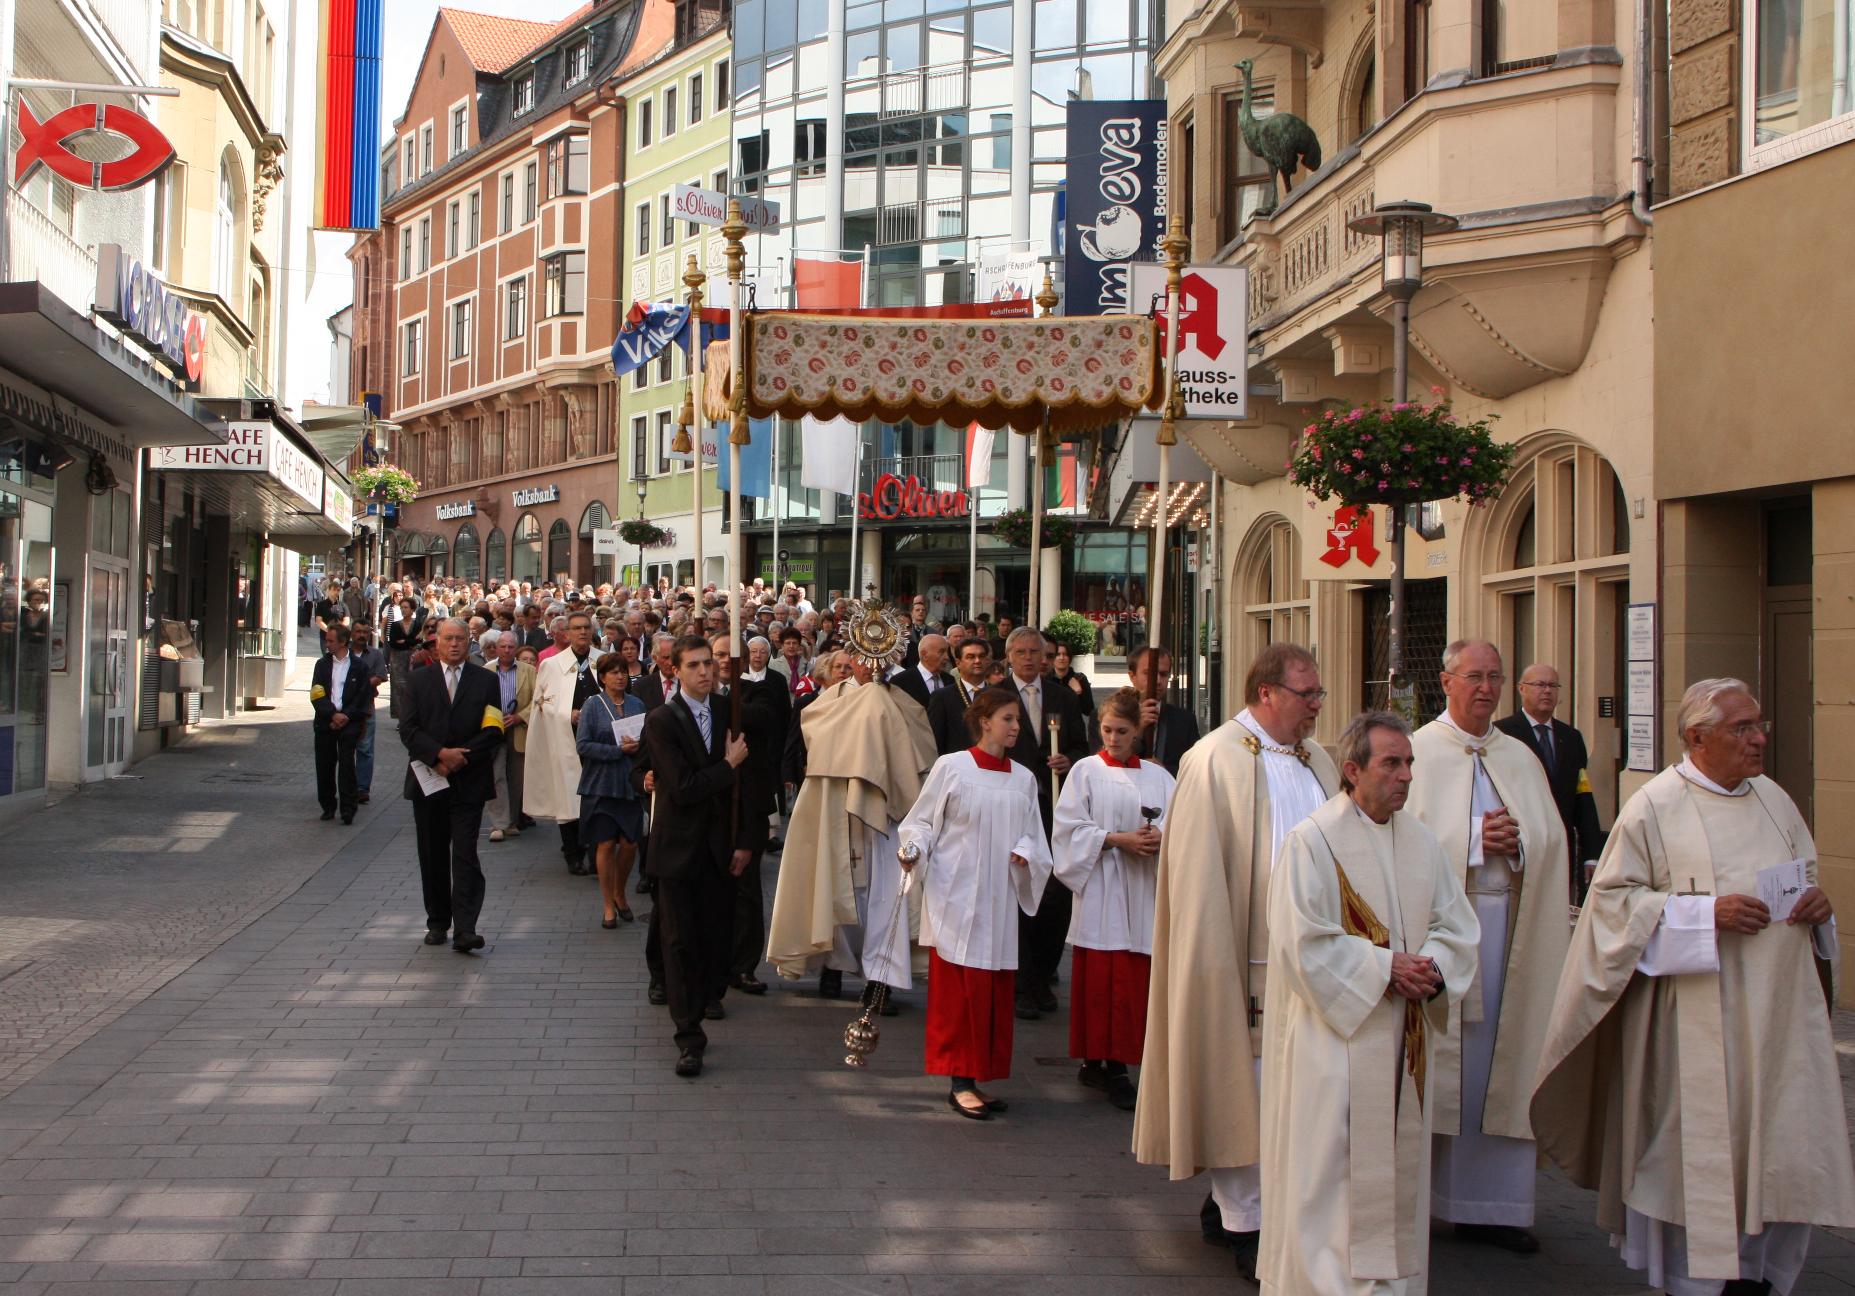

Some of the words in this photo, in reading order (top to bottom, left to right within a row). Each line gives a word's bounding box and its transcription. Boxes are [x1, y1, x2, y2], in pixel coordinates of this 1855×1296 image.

[1100, 117, 1142, 204] eva
[1153, 120, 1168, 216] Bademoden
[677, 191, 723, 220] s.Oliver
[985, 259, 1036, 274] ASCHAFENBUR
[1179, 370, 1236, 384] auss-
[1182, 387, 1239, 404] theke
[226, 428, 263, 446] AFE
[185, 447, 262, 465] HENCH
[275, 440, 293, 480] CAFE
[294, 457, 318, 498] HENCH
[512, 485, 556, 508] Volksbank
[858, 472, 970, 519] s.Oliver
[436, 500, 473, 520] Volksbank
